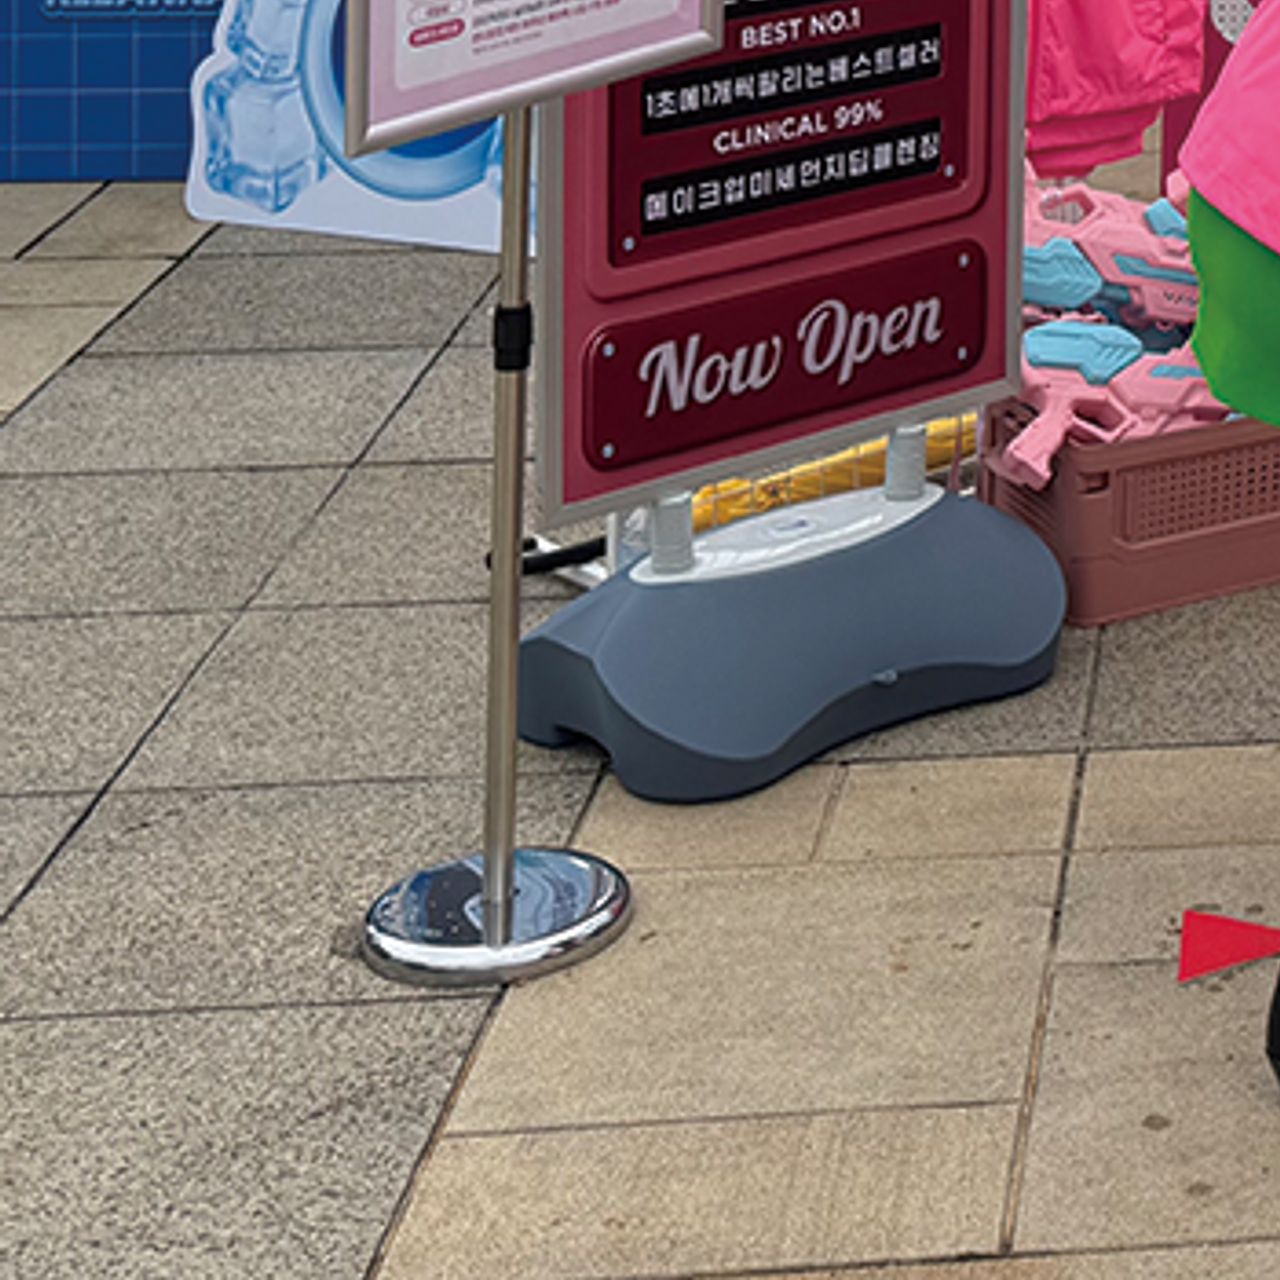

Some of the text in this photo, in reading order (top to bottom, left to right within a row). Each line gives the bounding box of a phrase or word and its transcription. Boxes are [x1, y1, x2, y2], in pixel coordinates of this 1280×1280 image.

[740, 6, 862, 50] BEST NO.1
[712, 98, 884, 154] CLINICAL 99%
[638, 295, 945, 419] Now Open
